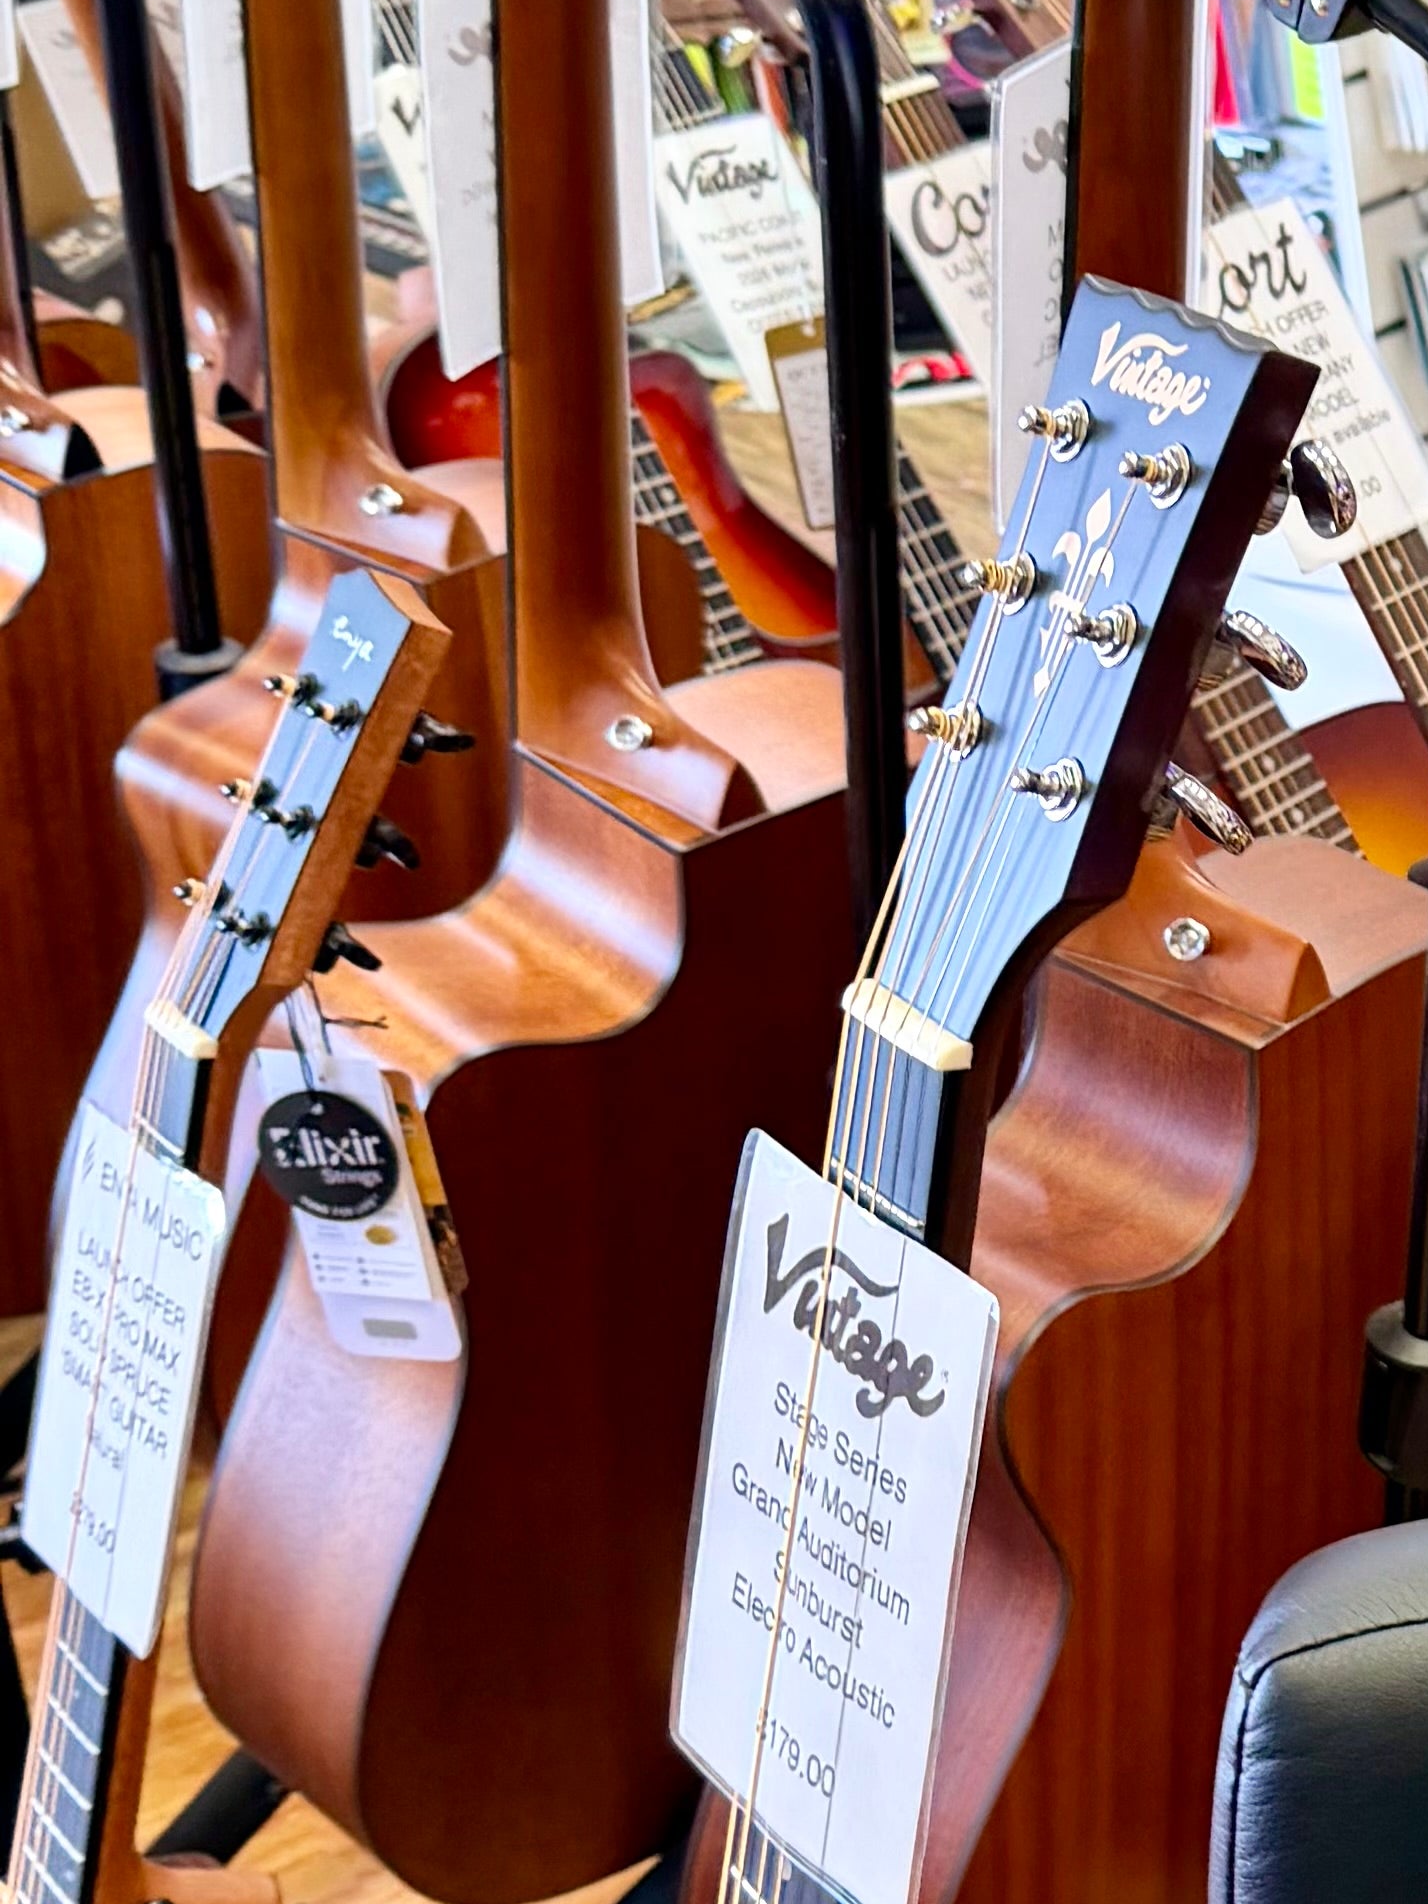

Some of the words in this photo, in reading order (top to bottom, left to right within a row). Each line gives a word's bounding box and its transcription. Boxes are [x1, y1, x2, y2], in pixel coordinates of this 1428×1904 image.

[666, 144, 780, 205] Vintage
[1219, 222, 1307, 314] ort
[1090, 321, 1211, 427] Vintage
[269, 1126, 381, 1168] Elixir
[142, 1196, 204, 1262] MUSIC
[131, 1275, 187, 1334] OFFER
[763, 1212, 948, 1420] Vintage
[142, 1328, 182, 1375] MAX
[774, 1381, 829, 1451] Stage
[833, 1430, 908, 1505] Series
[821, 1477, 892, 1553] Model
[774, 1549, 864, 1649] Sunburst
[796, 1516, 912, 1626] Auditorium
[799, 1637, 896, 1730] Acoustic
